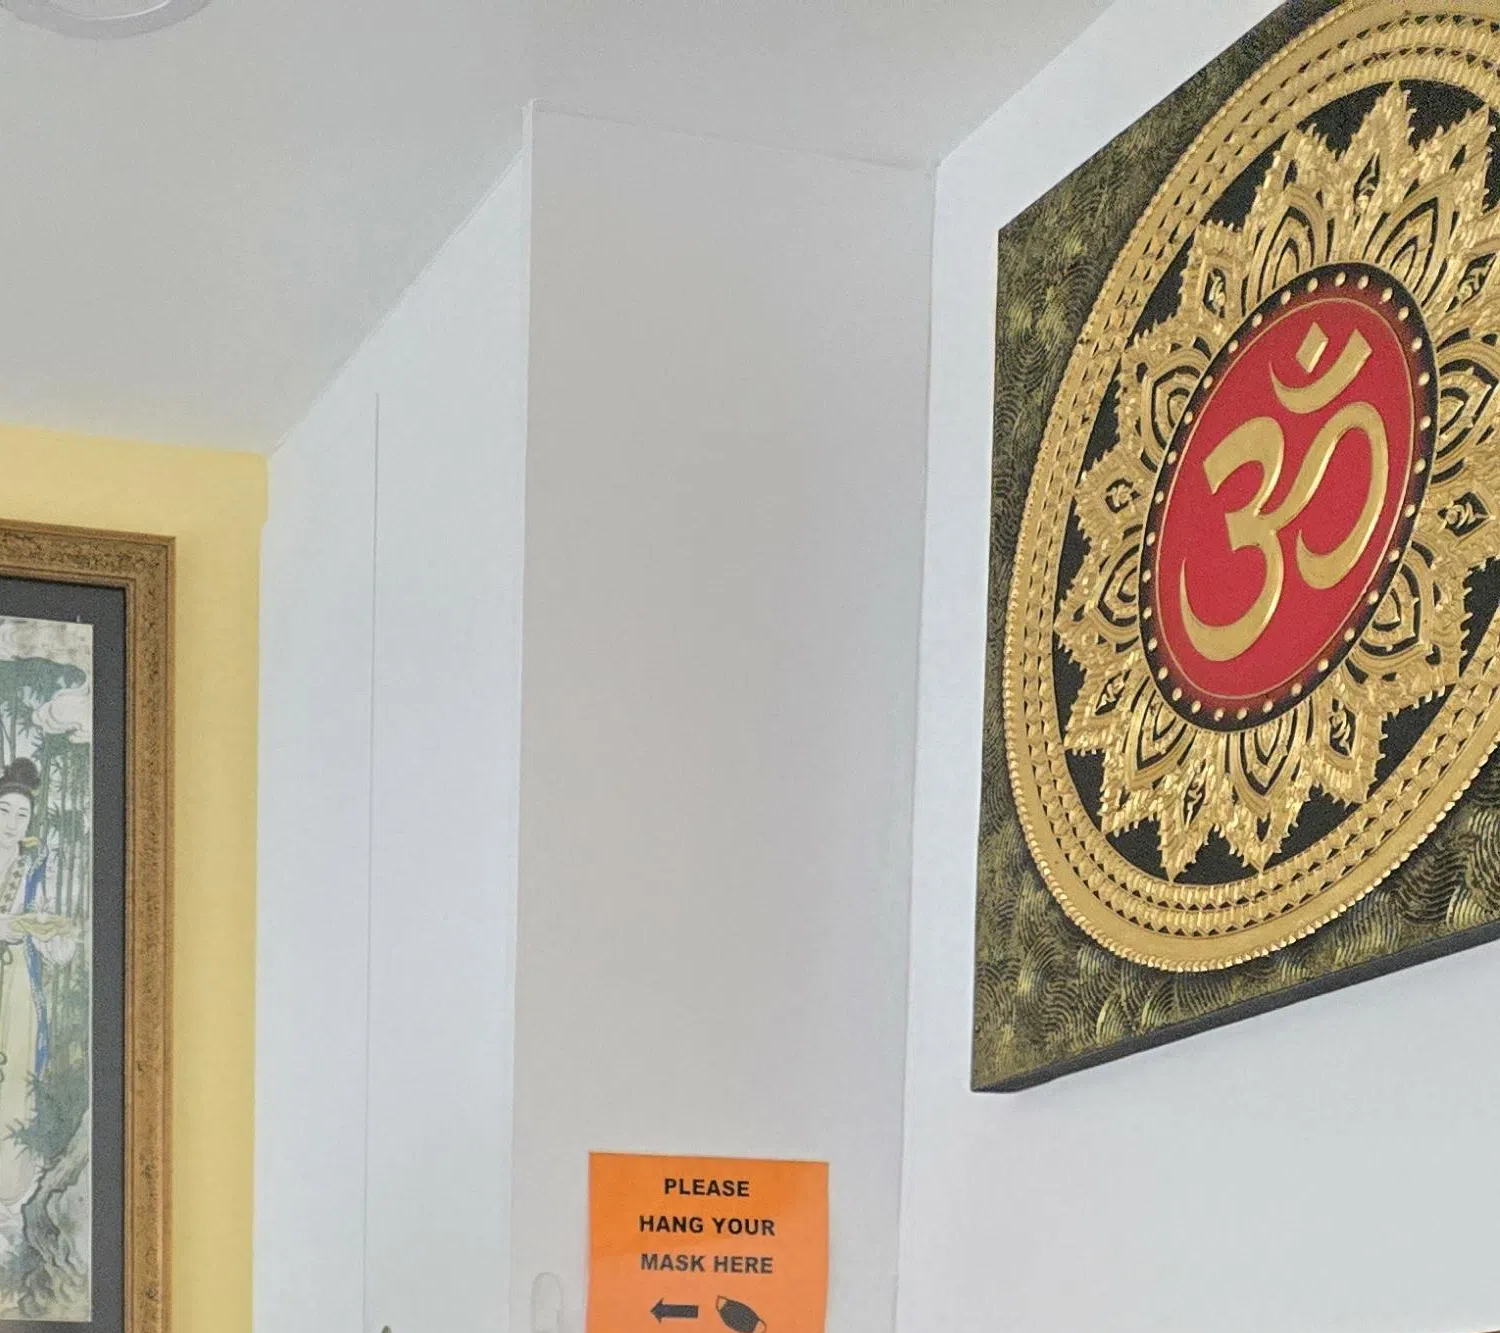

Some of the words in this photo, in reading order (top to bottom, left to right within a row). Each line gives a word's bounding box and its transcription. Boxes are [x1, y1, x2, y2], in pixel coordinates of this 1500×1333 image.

[663, 1177, 750, 1198] PLEASE
[639, 1215, 704, 1234] HANG
[712, 1217, 775, 1236] YOUR
[640, 1253, 705, 1272] MASK
[713, 1255, 773, 1274] HERE
